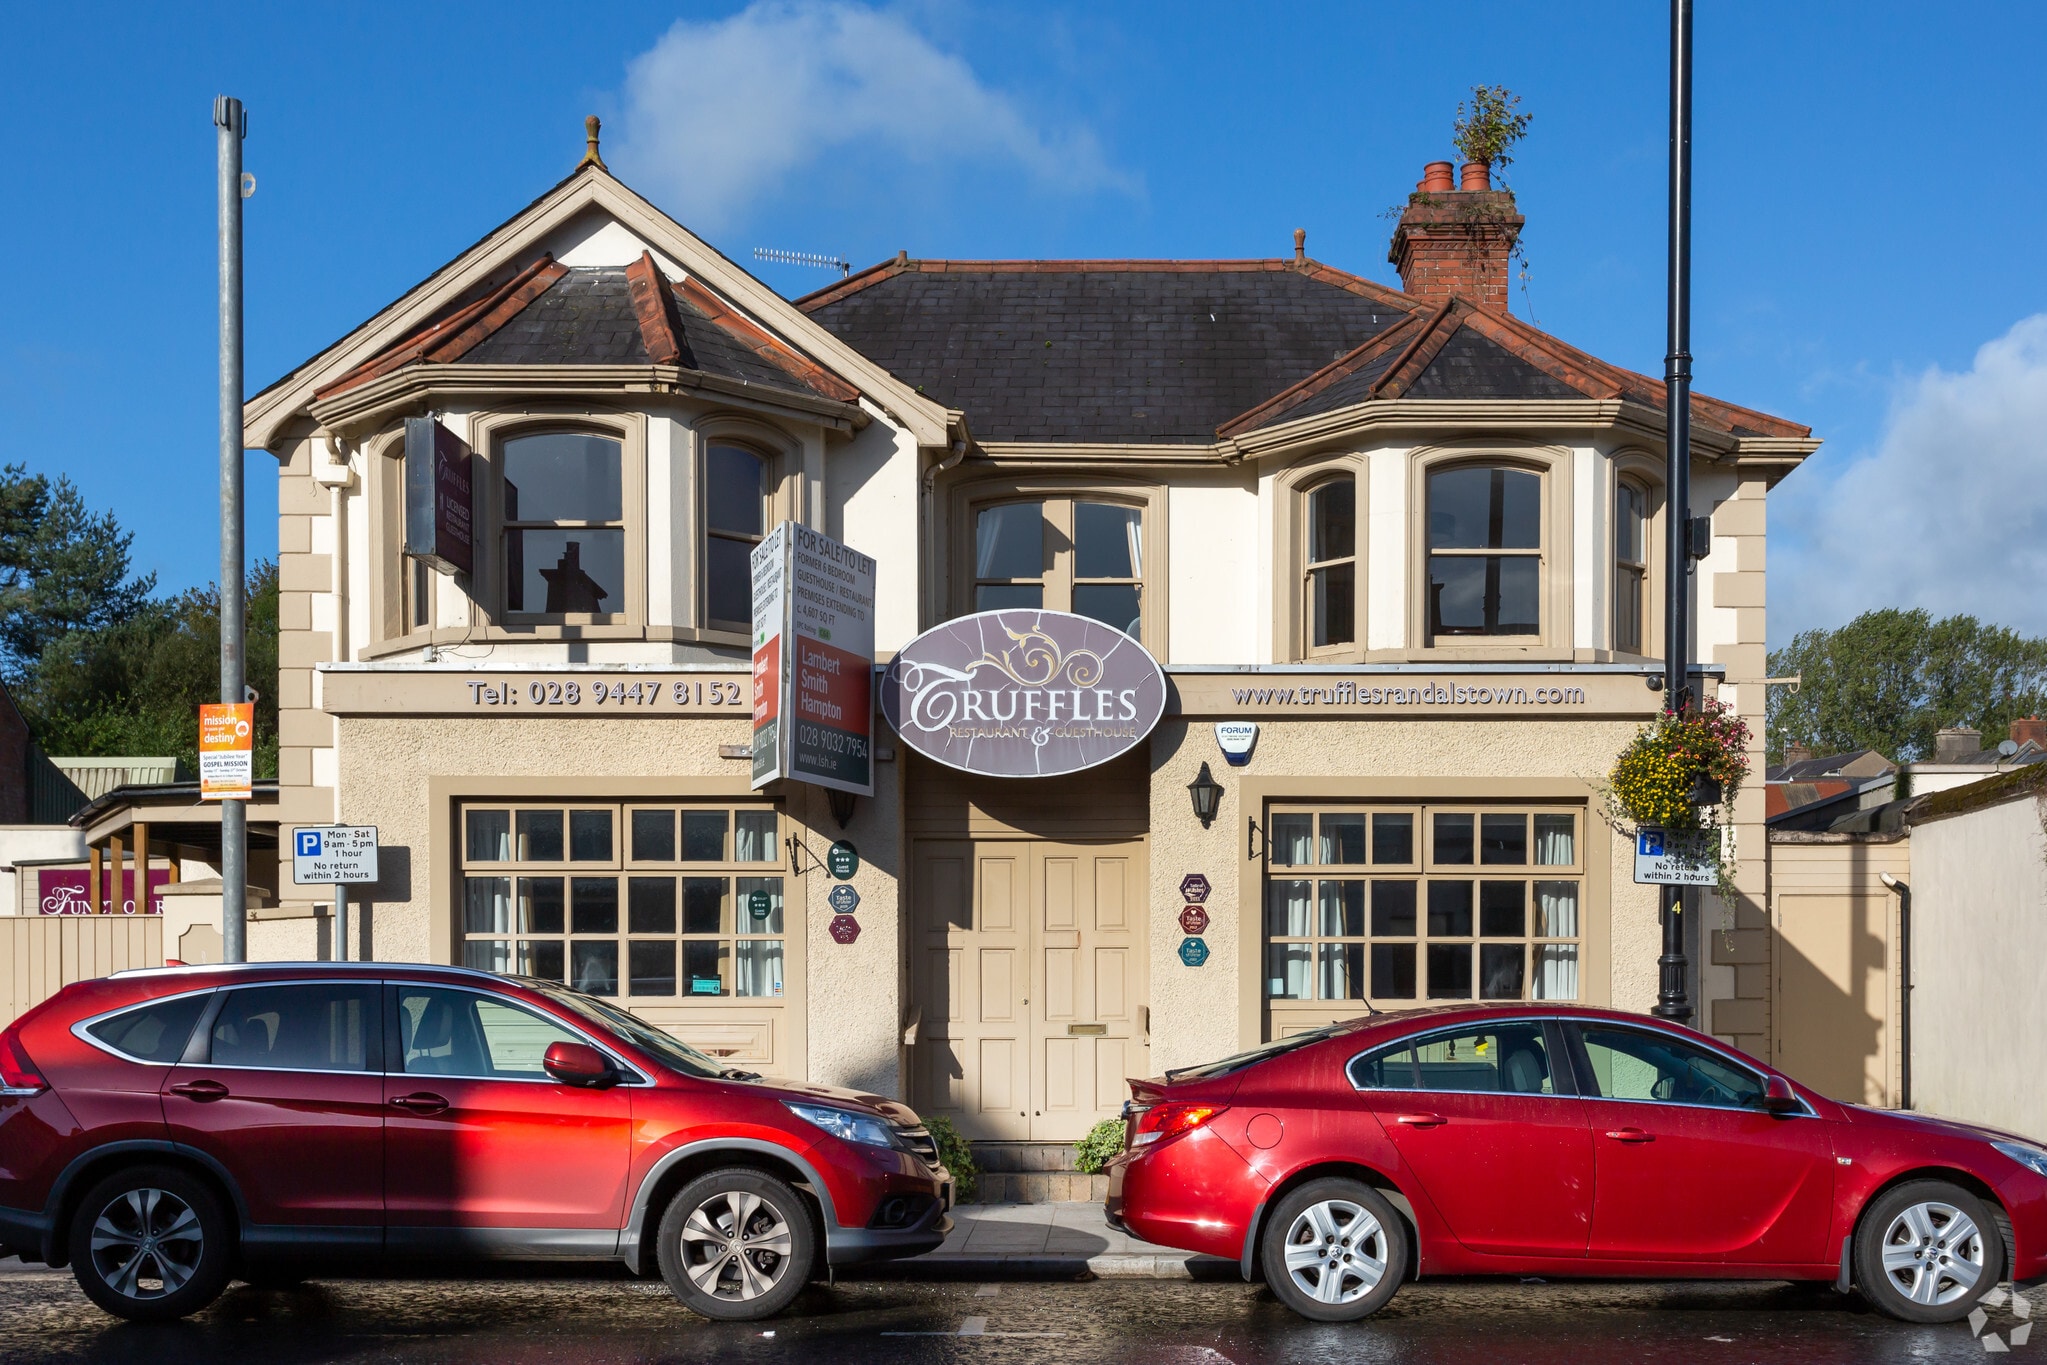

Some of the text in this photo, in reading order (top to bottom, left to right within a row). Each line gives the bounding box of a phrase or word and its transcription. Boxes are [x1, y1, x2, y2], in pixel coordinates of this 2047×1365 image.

[446, 495, 470, 521] LICENSED
[798, 528, 816, 552] FOR
[857, 556, 872, 577] LET
[798, 552, 856, 585] FORMER 6 BEDROOM
[797, 569, 835, 593] GUESTHOUSE
[839, 586, 872, 608] RESTAURANT
[797, 586, 825, 606] PREMISES
[826, 596, 856, 615] EXTENDING
[857, 609, 865, 621] TO
[829, 614, 835, 625] FT
[803, 645, 840, 675] Lambert
[801, 669, 828, 694] Smith
[466, 681, 742, 705] Tel: 028 9447 8152
[892, 660, 1137, 732] TRUFFLES
[1231, 681, 1585, 705] www.trufflesrandalstown.com
[801, 692, 841, 720] Hampton
[204, 715, 237, 725] mission
[204, 733, 236, 745] destiny
[800, 725, 818, 746] 028
[821, 730, 843, 753] 9032
[846, 737, 867, 759] 7954
[950, 727, 1137, 746] RESTAURANT & GUESTHOUSE
[799, 753, 837, 770] www.lsh.ie
[354, 830, 370, 838] Sat
[1646, 834, 1660, 853] P
[303, 835, 318, 854] P
[314, 862, 327, 870] No
[343, 871, 369, 879] hours
[1655, 862, 1668, 870] No
[1644, 872, 1672, 880] within
[1684, 873, 1710, 881] hours
[1671, 901, 1681, 914] 4
